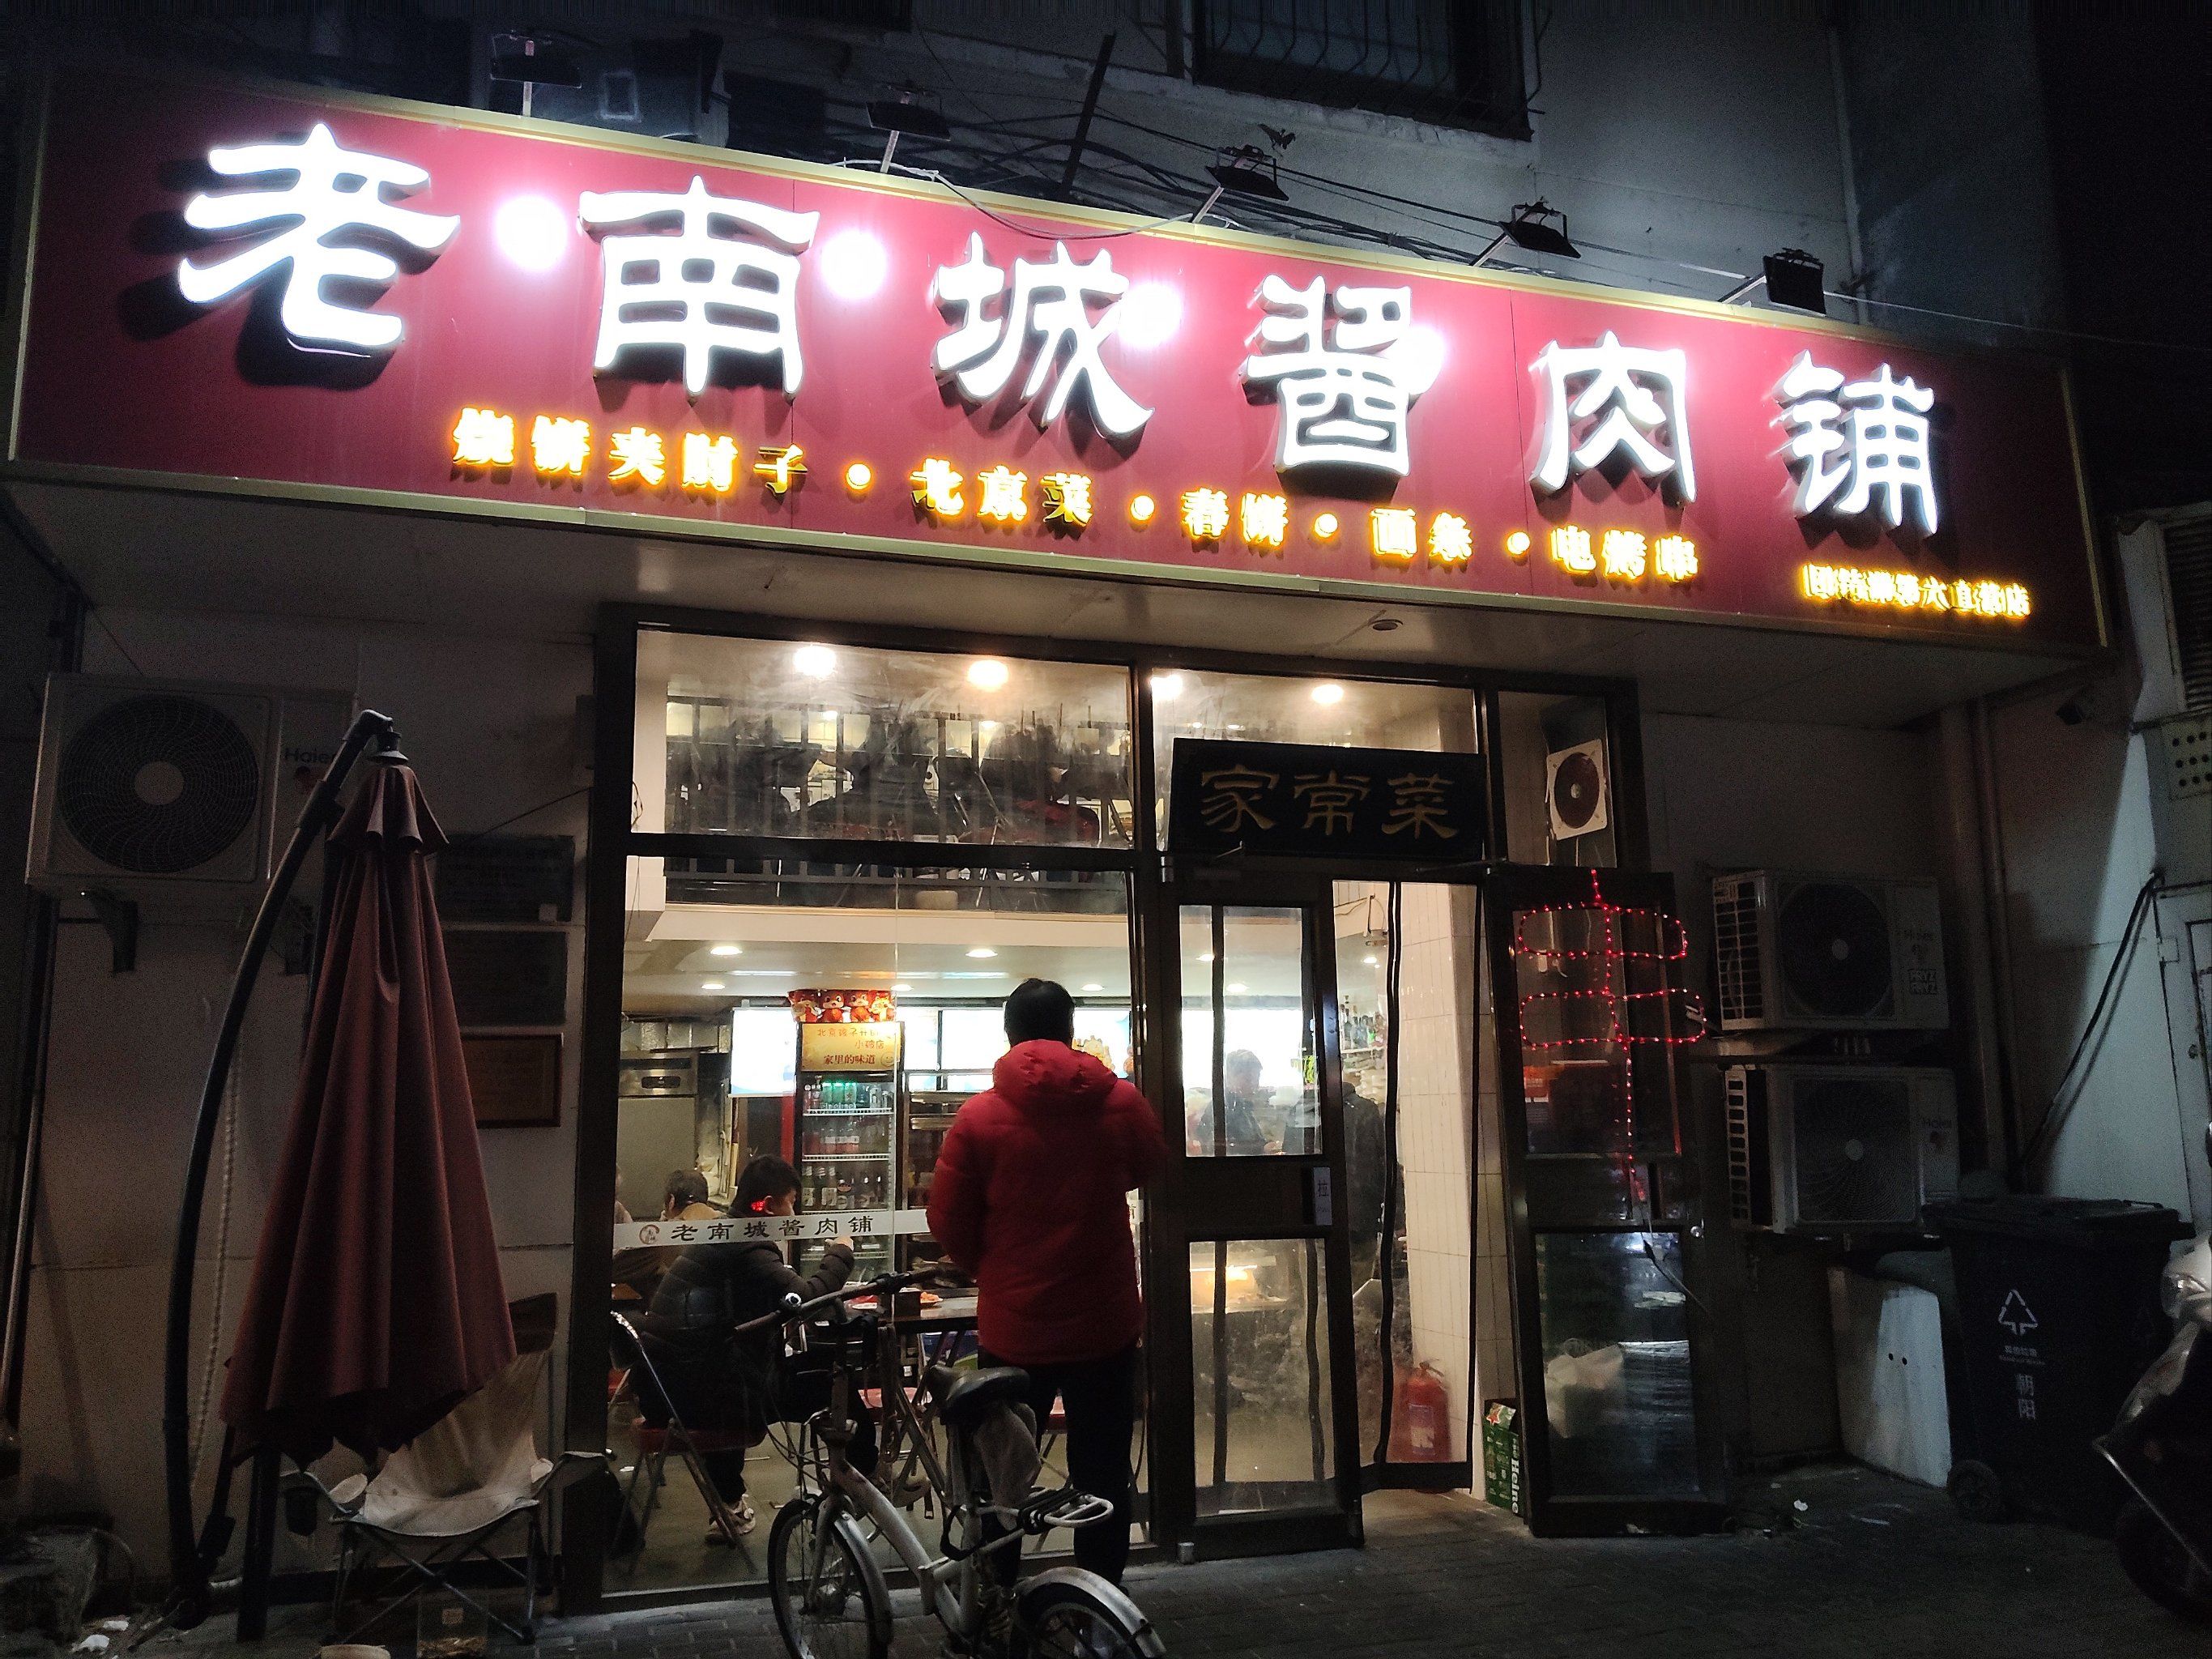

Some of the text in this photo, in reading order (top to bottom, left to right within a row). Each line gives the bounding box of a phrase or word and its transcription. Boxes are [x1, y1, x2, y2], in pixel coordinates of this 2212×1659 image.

[177, 122, 1939, 538] 老南城酱肉铺
[909, 458, 1093, 526] 北京菜
[1200, 763, 1460, 840] 家常菜
[823, 1054, 876, 1064] 家里的味道
[671, 1214, 874, 1242] 老南城酱肉铺
